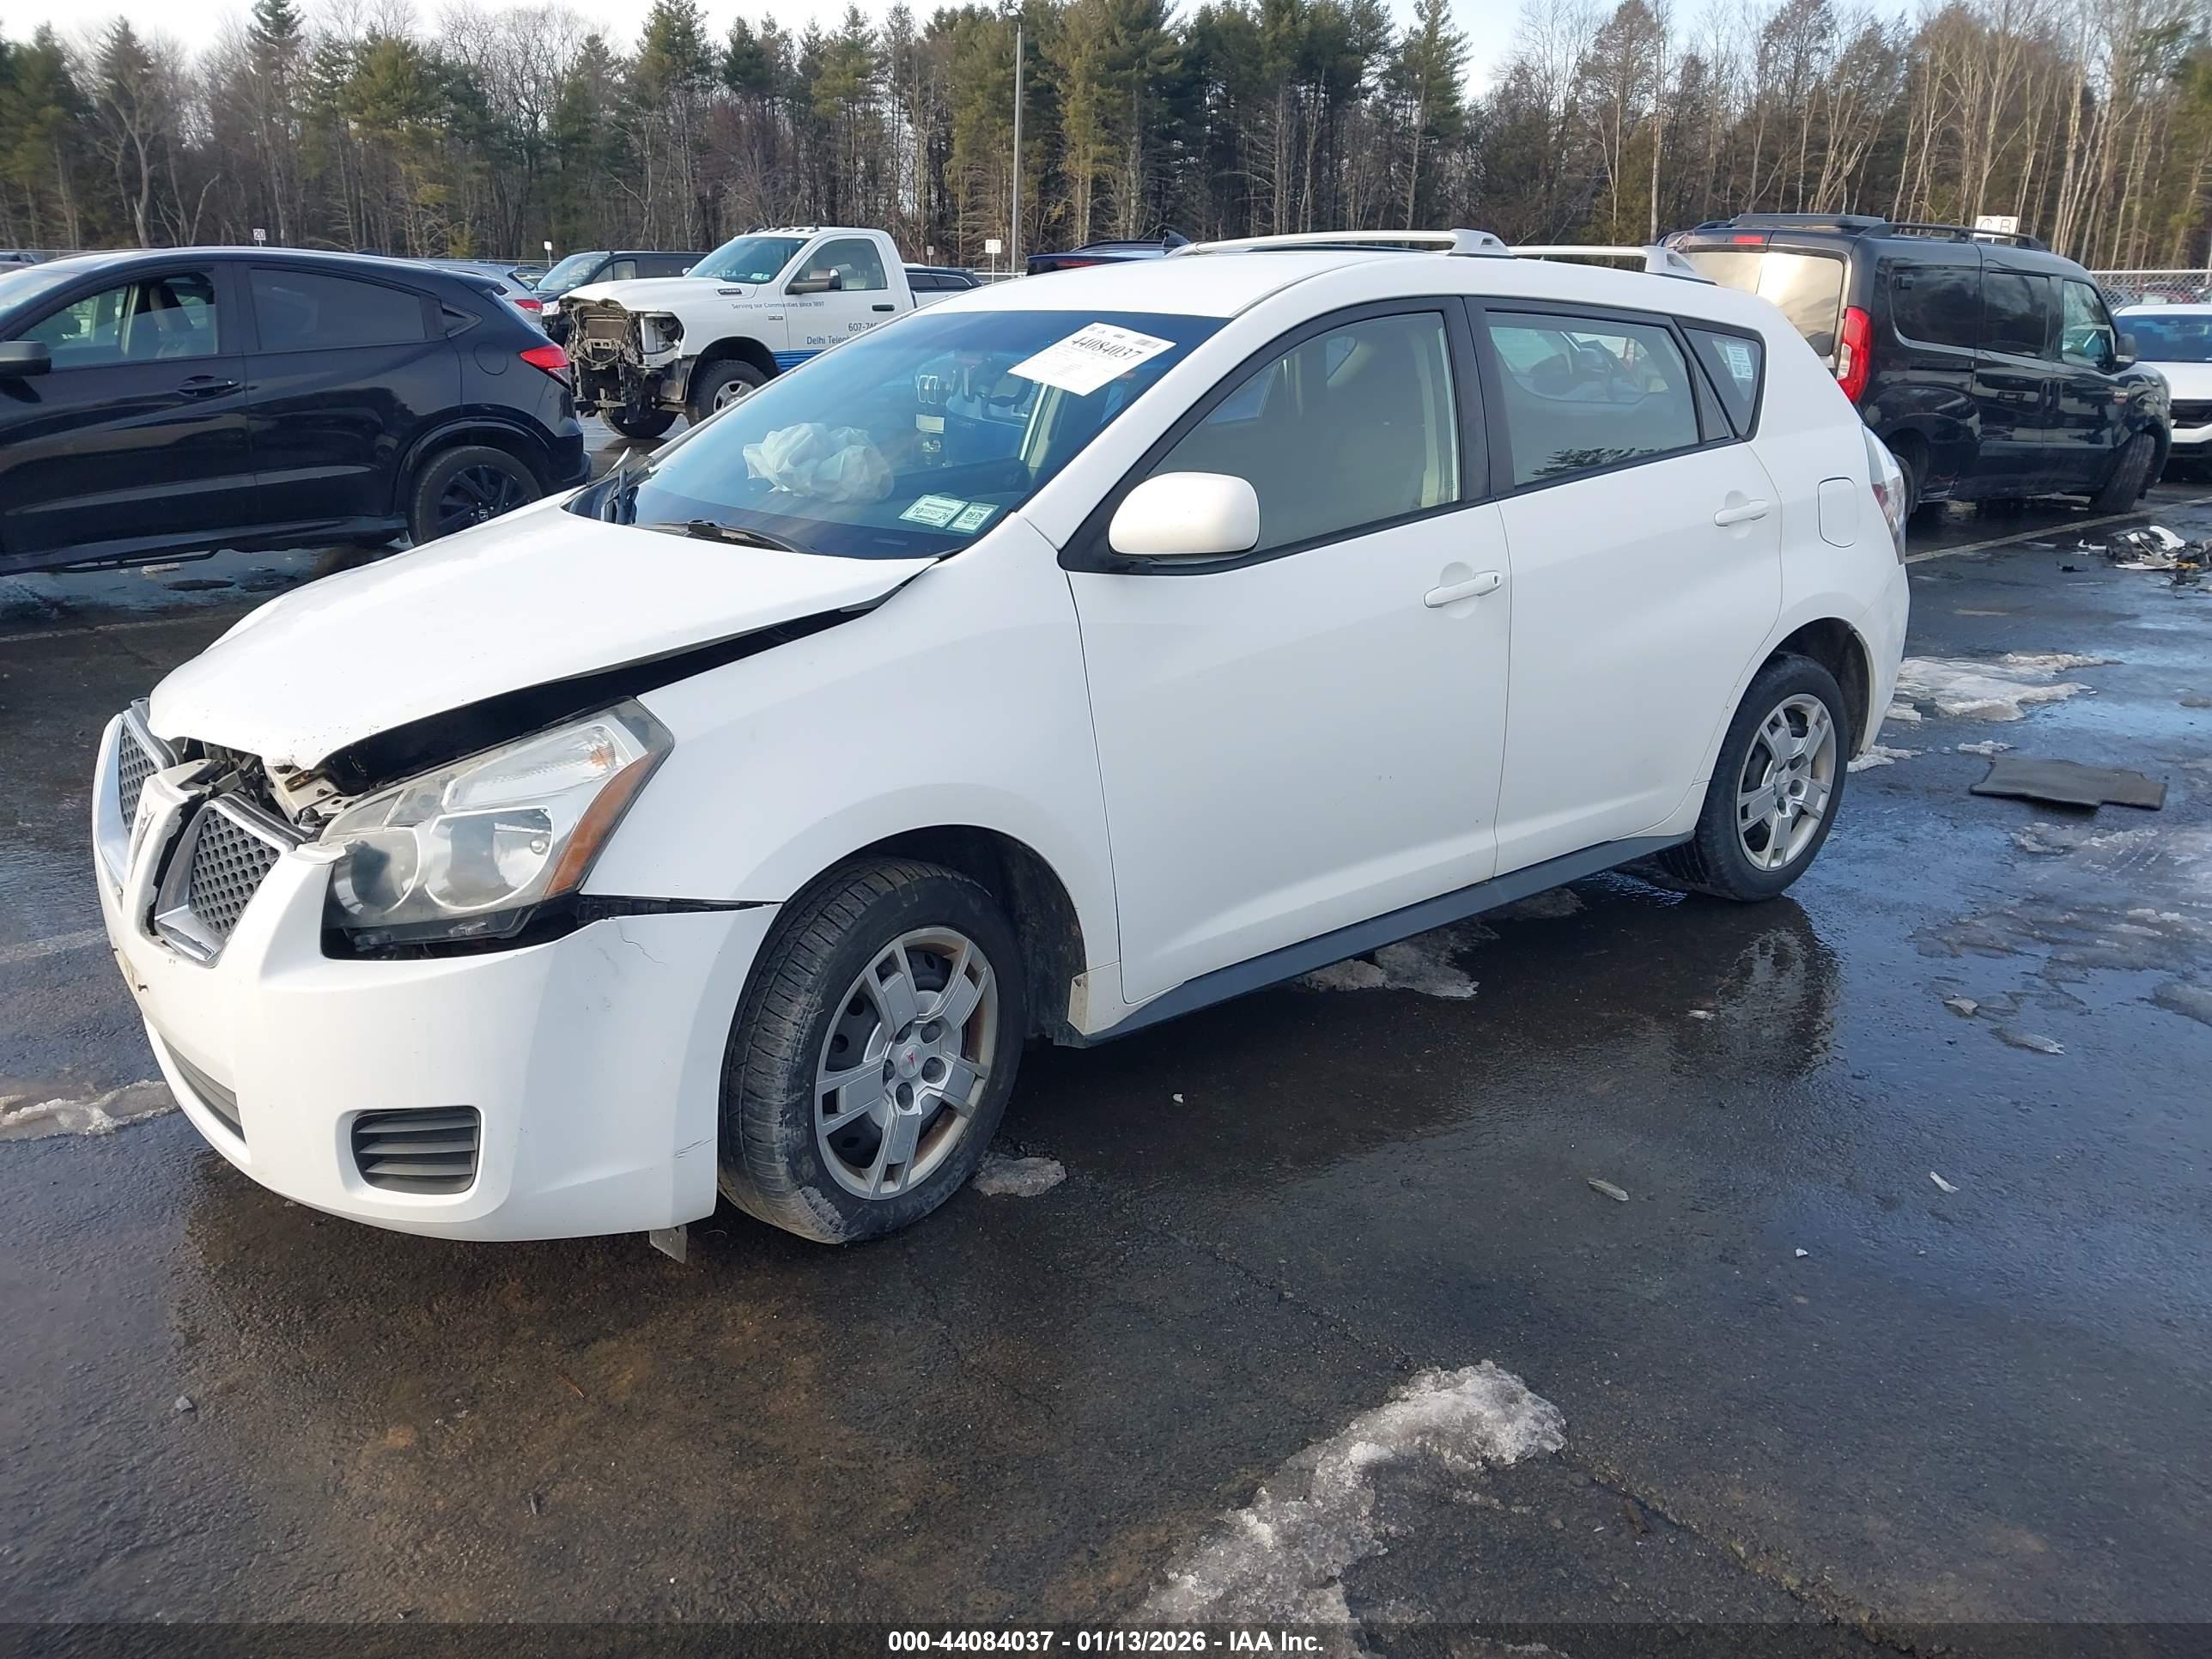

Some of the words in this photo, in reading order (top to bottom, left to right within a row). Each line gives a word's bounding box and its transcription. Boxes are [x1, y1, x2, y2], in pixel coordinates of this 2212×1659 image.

[254, 230, 264, 239] 20
[806, 336, 826, 344] Delhi
[1072, 336, 1143, 361] 44084037
